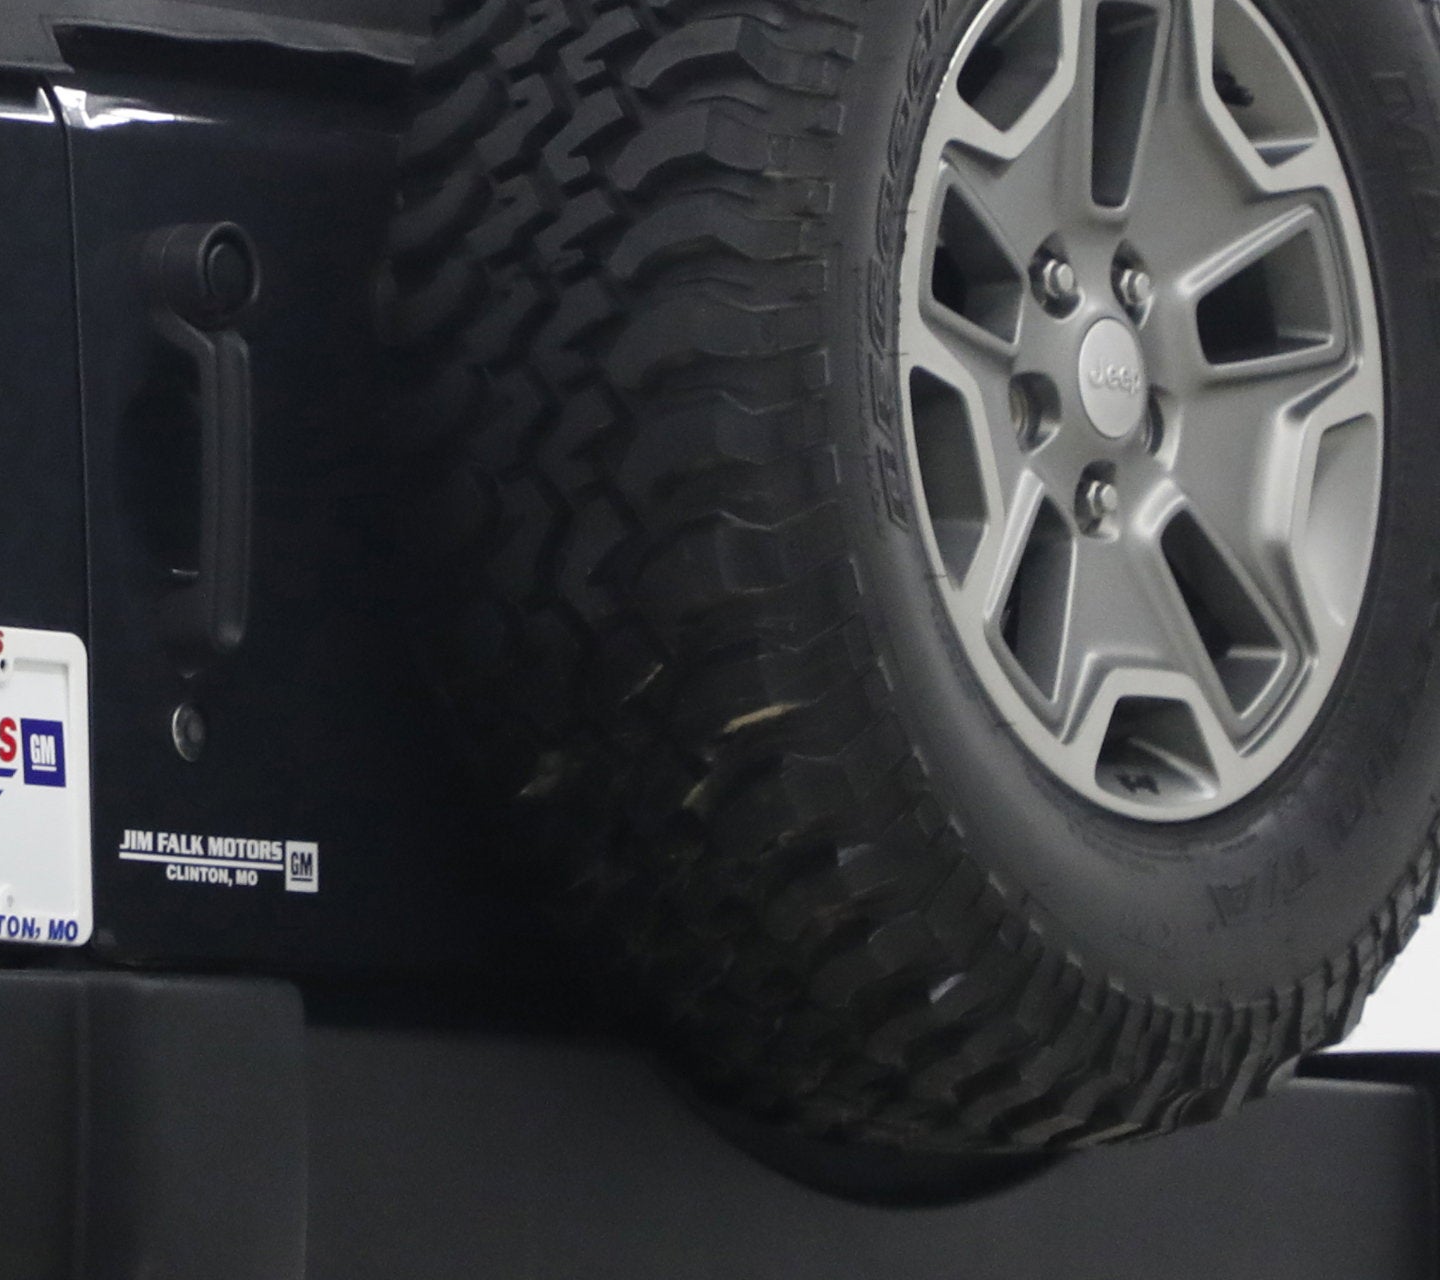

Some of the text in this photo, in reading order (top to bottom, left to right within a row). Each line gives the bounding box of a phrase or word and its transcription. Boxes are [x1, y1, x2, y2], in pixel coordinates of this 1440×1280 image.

[1087, 353, 1142, 399] Jeep
[29, 732, 57, 766] GM
[119, 829, 313, 878] JIM FALK MOTORS GM
[166, 864, 258, 887] CLINTON, MO
[48, 919, 79, 942] MO
